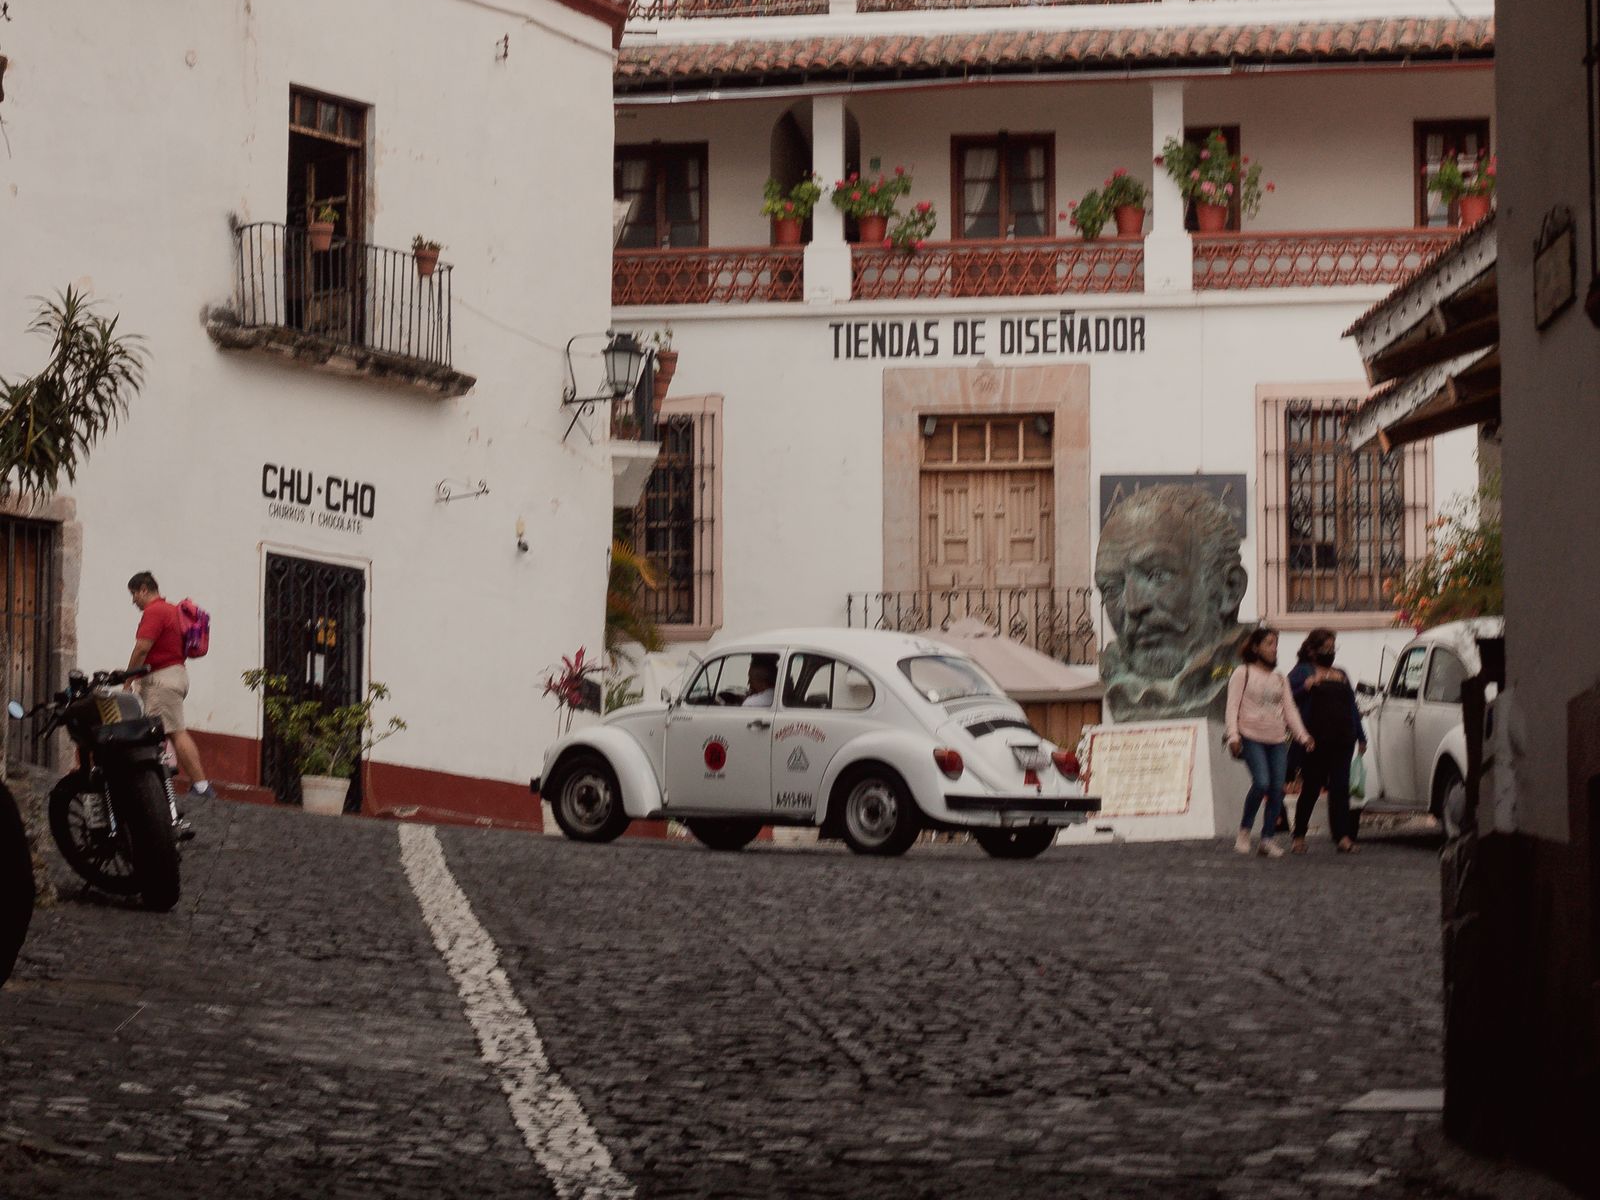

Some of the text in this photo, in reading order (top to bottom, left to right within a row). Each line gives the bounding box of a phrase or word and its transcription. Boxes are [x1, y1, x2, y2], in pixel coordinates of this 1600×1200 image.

[829, 309, 1146, 359] TIENDAS DE DISEÑADOR
[268, 502, 363, 534] CHURROS Y CHOCOLATE
